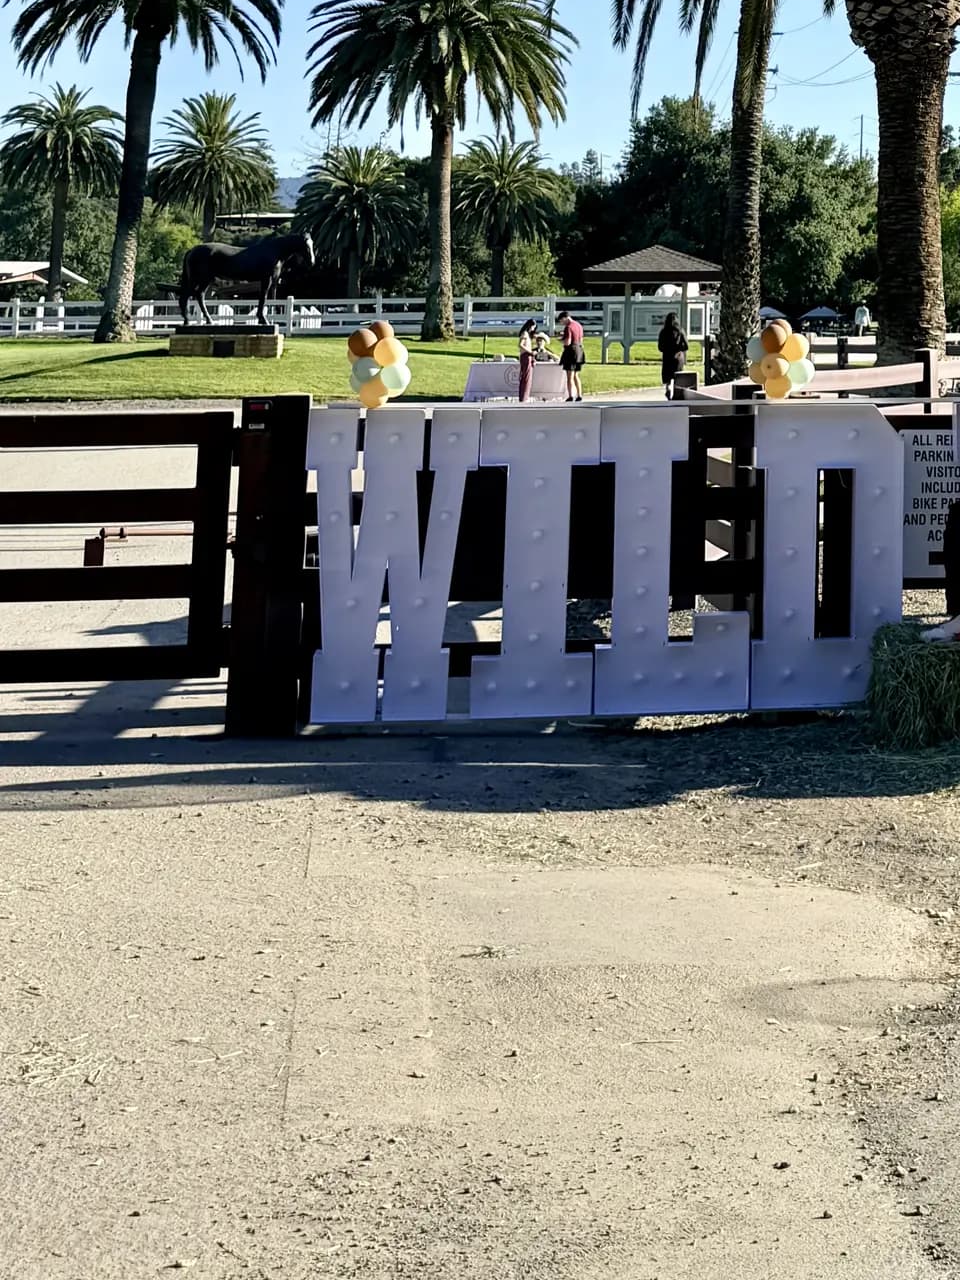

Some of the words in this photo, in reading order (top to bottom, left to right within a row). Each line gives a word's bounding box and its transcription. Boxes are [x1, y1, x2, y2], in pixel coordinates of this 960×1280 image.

[912, 434, 933, 446] ALL
[912, 497, 937, 510] BIKE
[903, 513, 926, 526] AND
[927, 529, 945, 542] AC
[305, 404, 904, 724] WILD
